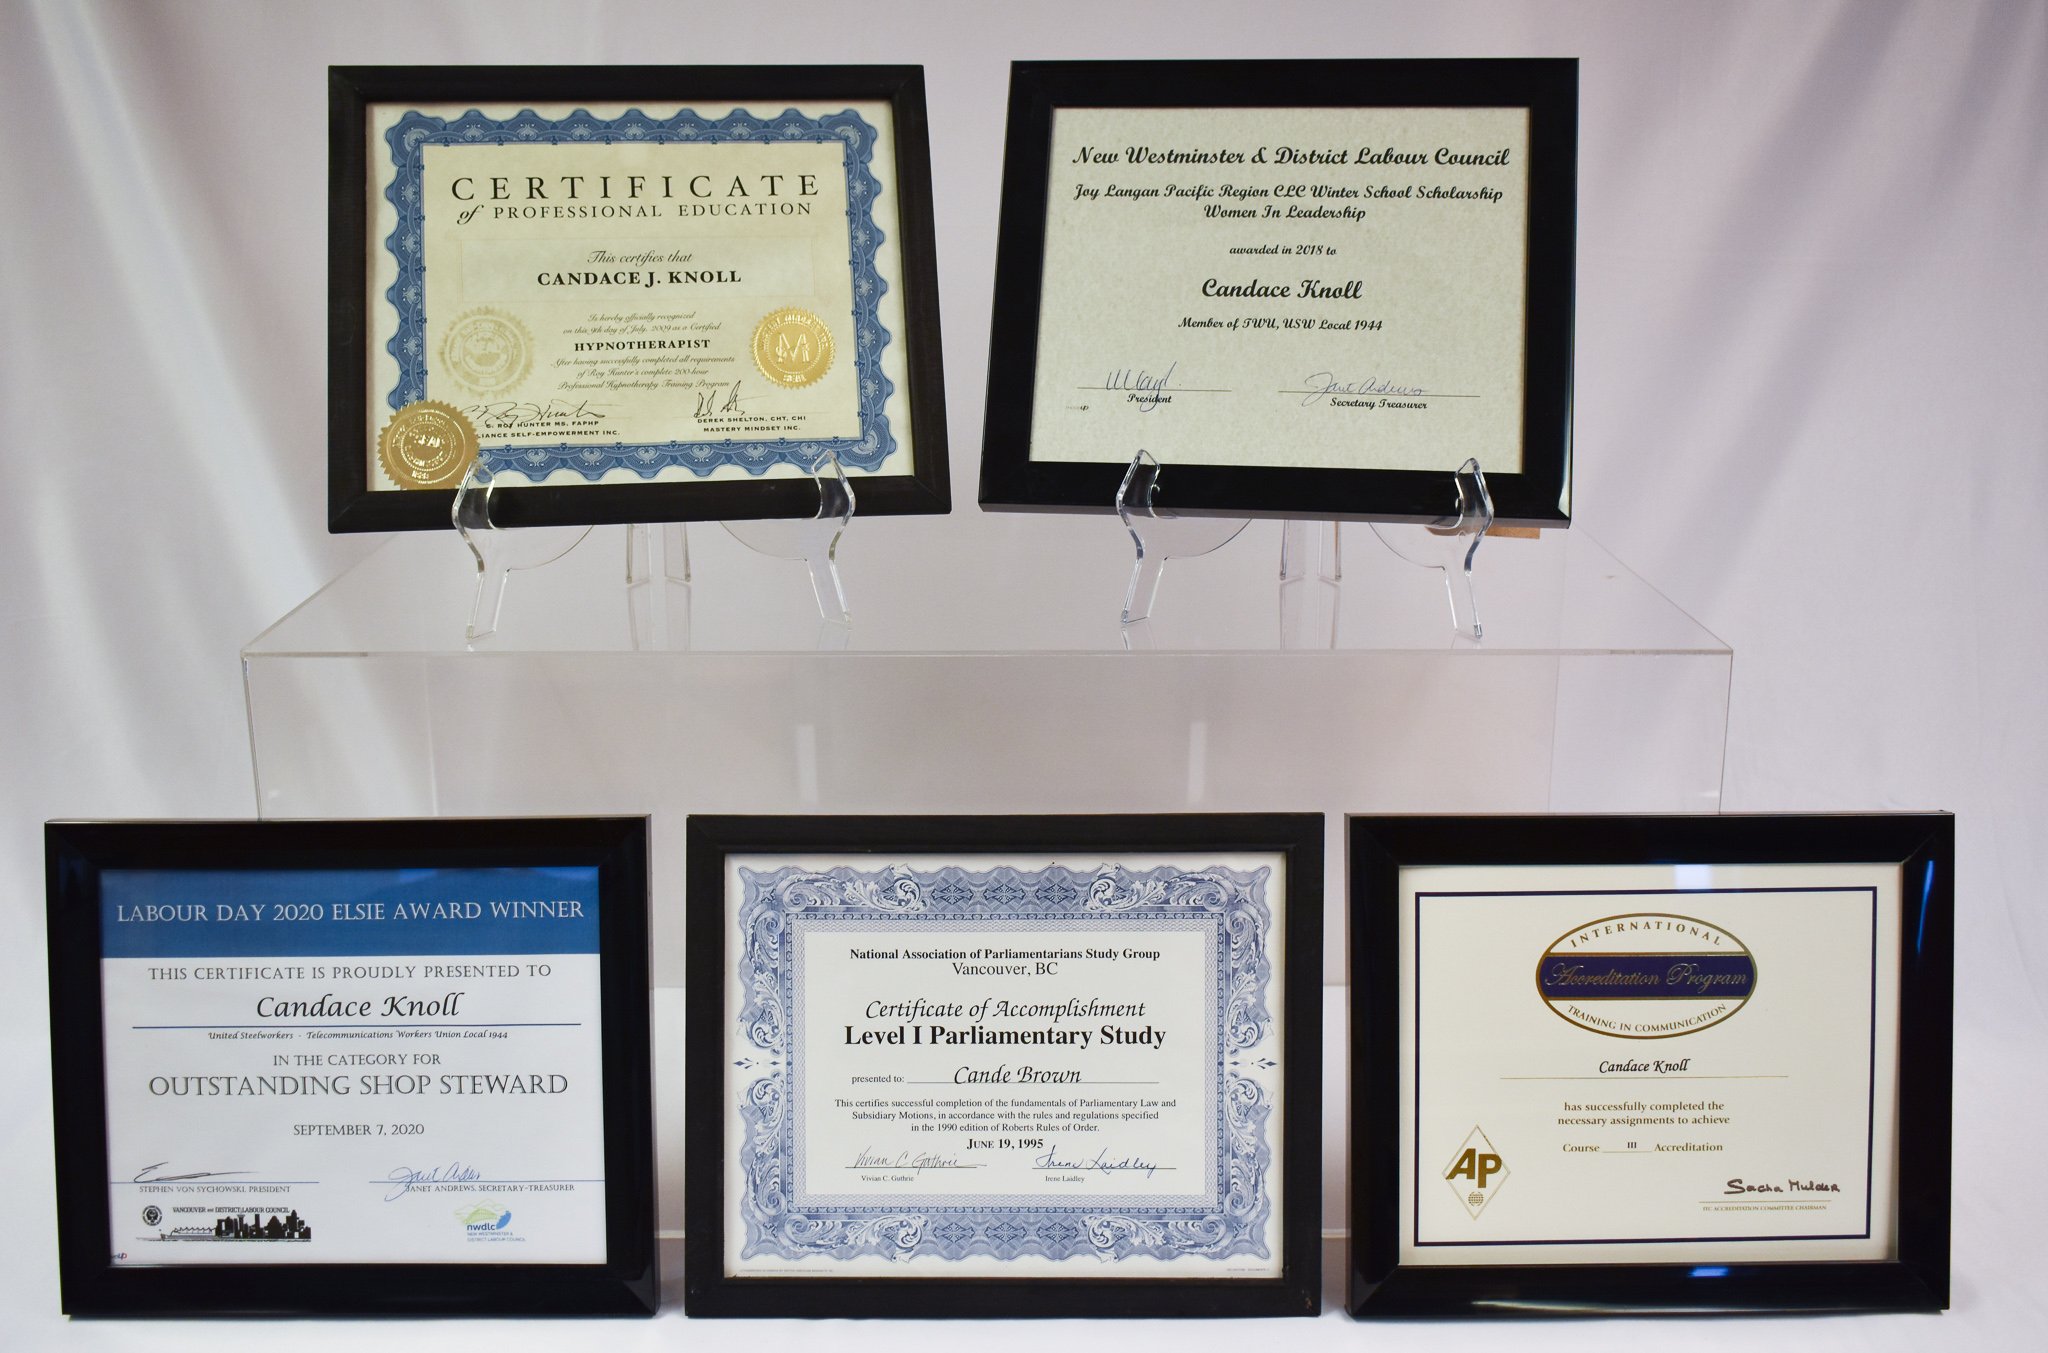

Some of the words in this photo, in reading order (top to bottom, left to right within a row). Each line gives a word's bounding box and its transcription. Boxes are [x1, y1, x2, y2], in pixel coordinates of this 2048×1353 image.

[1072, 146, 1119, 164] New
[1125, 146, 1245, 164] Westminster
[1251, 147, 1268, 164] &
[1274, 146, 1348, 165] District
[1354, 147, 1429, 165] Labour
[1434, 147, 1510, 166] Council
[452, 175, 819, 201] CERTIFICATE
[1073, 184, 1100, 201] Joy
[1104, 184, 1160, 201] Langan
[1164, 184, 1214, 201] Pacific
[1218, 184, 1269, 201] Region
[1274, 185, 1306, 198] CLC
[1310, 185, 1360, 199] Winter
[1363, 185, 1412, 199] School
[1416, 186, 1503, 204] Scholarship
[457, 204, 485, 225] of
[494, 205, 662, 219] PROFESSIONAL
[679, 202, 810, 217] EDUCATION
[1204, 205, 1257, 218] Women
[1261, 205, 1282, 218] In
[1285, 205, 1366, 222] Leadership
[1229, 244, 1279, 255] awarded
[1282, 245, 1292, 255] in
[1295, 245, 1324, 255] 2018
[1326, 246, 1337, 256] to
[587, 250, 616, 264] This
[619, 250, 664, 267] certifies
[667, 250, 693, 263] that
[537, 272, 641, 286] CANDACE
[645, 272, 661, 288] J.
[668, 270, 741, 284] KNOLL
[1202, 278, 1291, 298] Candace
[1297, 280, 1363, 300] Knoll
[1178, 317, 1224, 328] Member
[1227, 318, 1240, 331] of
[1242, 318, 1280, 330] TWU,
[1283, 318, 1316, 329] USW
[1318, 319, 1352, 331] Local
[1355, 320, 1383, 331] 1944
[575, 339, 710, 352] HYPNOTHERAPIST
[1127, 393, 1172, 403] President
[1330, 398, 1376, 411] Secretary
[1378, 399, 1428, 409] Treasurer
[118, 905, 208, 922] LABOUR
[216, 904, 266, 921] DAY
[273, 904, 324, 921] 2020
[332, 903, 385, 920] ELSIE
[393, 902, 482, 920] AWARD
[490, 901, 584, 918] WINNER
[1570, 921, 1720, 947] INTERNATIONAL
[851, 949, 899, 959] National
[902, 949, 967, 959] Association
[970, 949, 982, 959] of
[984, 948, 1083, 959] Parliamentarians
[1086, 948, 1119, 961] Study
[1123, 949, 1160, 961] Group
[148, 968, 187, 980] THIS
[194, 967, 305, 980] CERTIFICATE
[312, 967, 325, 979] IS
[333, 966, 416, 979] PROUDLY
[424, 965, 520, 978] PRESENTED
[526, 964, 552, 977] TO
[952, 962, 1031, 977] Vancouver,
[1035, 962, 1058, 975] BC
[1545, 962, 1660, 986] Accreditation
[1666, 963, 1746, 994] Program
[257, 994, 371, 1018] Candace
[381, 992, 465, 1017] Knoll
[866, 998, 963, 1024] Certificate
[969, 998, 991, 1022] of
[993, 998, 1146, 1022] Accomplishment
[1568, 1004, 1617, 1030] TRAINING
[1620, 1023, 1632, 1032] IN
[1635, 1003, 1727, 1032] COMMUNICATION
[845, 1026, 905, 1045] Level
[913, 1026, 922, 1045] I
[930, 1025, 1093, 1050] Parliamentary
[1101, 1025, 1166, 1050] Study
[273, 1055, 289, 1066] IN
[293, 1055, 323, 1066] THE
[328, 1054, 408, 1066] CATEGORY
[413, 1054, 441, 1065] FOR
[1599, 1059, 1650, 1074] Candace
[1653, 1058, 1691, 1074] Knoll
[851, 1074, 892, 1085] presented
[953, 1064, 1011, 1084] Cande
[1017, 1067, 1082, 1083] Brown
[149, 1075, 351, 1096] OUTSTANDING
[360, 1075, 431, 1095] SHOP
[440, 1074, 568, 1095] STEWARD
[835, 1099, 854, 1107] This
[855, 1099, 889, 1107] certifies
[891, 1099, 934, 1107] successful
[936, 1099, 983, 1109] completion
[984, 1099, 994, 1107] of
[996, 1099, 1009, 1107] the
[1011, 1099, 1066, 1107] fundamentals
[1068, 1099, 1078, 1107] of
[1080, 1099, 1138, 1109] Parliamentary
[1140, 1099, 1159, 1107] Law
[1161, 1099, 1176, 1107] and
[1564, 1102, 1582, 1111] has
[1585, 1101, 1647, 1113] successfully
[1649, 1101, 1705, 1113] completed
[1708, 1101, 1725, 1111] the
[852, 1111, 897, 1122] Subsidiary
[899, 1111, 937, 1120] Motions,
[938, 1111, 947, 1119] in
[948, 1111, 995, 1120] accordance
[997, 1111, 1016, 1119] with
[1018, 1111, 1031, 1120] the
[1033, 1111, 1053, 1120] rules
[1055, 1111, 1071, 1120] and
[1073, 1111, 1119, 1122] regulations
[1121, 1111, 1159, 1122] specified
[1558, 1118, 1607, 1127] necessary
[1610, 1116, 1675, 1127] assignments
[1678, 1117, 1689, 1125] to
[1691, 1115, 1730, 1124] achieve
[294, 1124, 372, 1136] SEPTEMBER
[376, 1124, 387, 1136] 7,
[391, 1124, 425, 1135] 2020
[911, 1123, 919, 1132] in
[922, 1123, 935, 1132] the
[938, 1123, 958, 1132] 1990
[959, 1123, 989, 1132] edition
[990, 1123, 1000, 1132] of
[1002, 1123, 1034, 1132] Roberts
[1036, 1123, 1060, 1132] Rules
[1062, 1123, 1072, 1132] of
[1073, 1123, 1100, 1132] Order.
[999, 1139, 1015, 1150] 19,
[1019, 1139, 1044, 1149] 1995
[1563, 1144, 1600, 1152] Course
[1654, 1142, 1723, 1152] Accreditation
[1445, 1147, 1503, 1189] AP
[1062, 1175, 1085, 1183] Laidley
